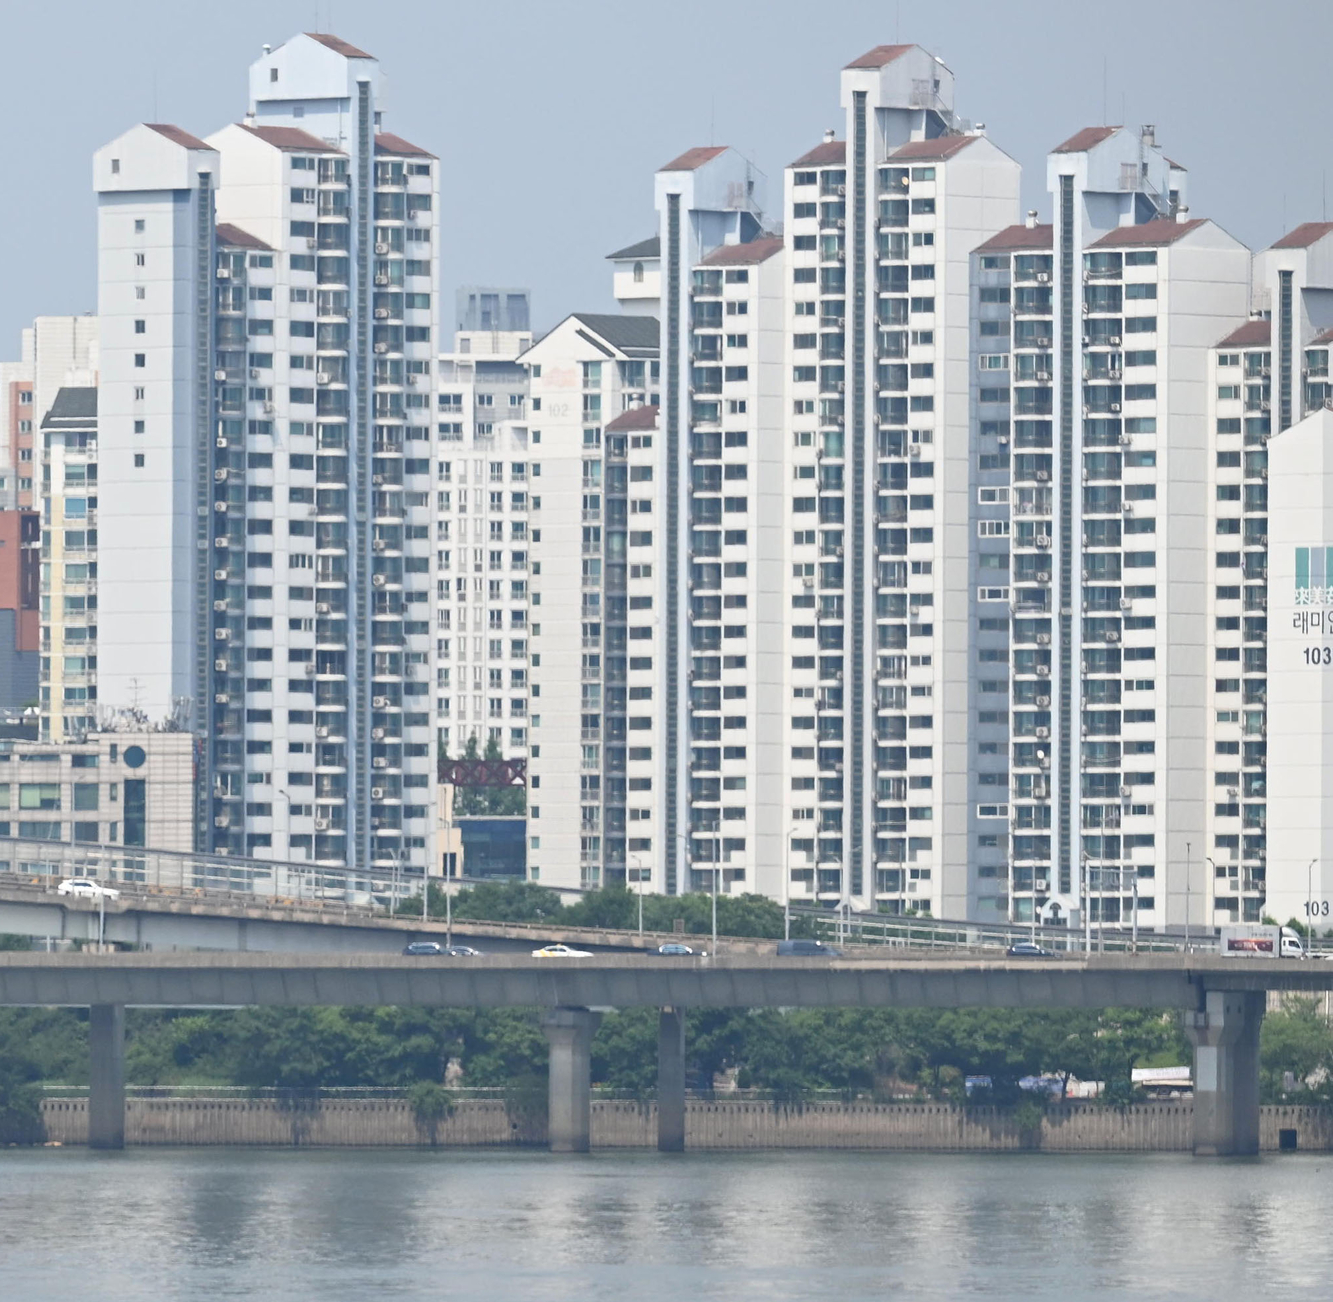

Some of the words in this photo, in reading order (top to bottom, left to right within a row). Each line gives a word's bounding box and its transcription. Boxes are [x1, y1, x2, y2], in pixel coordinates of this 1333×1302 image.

[549, 403, 568, 417] 102
[1303, 646, 1332, 665] 103
[1304, 901, 1330, 916] 103
